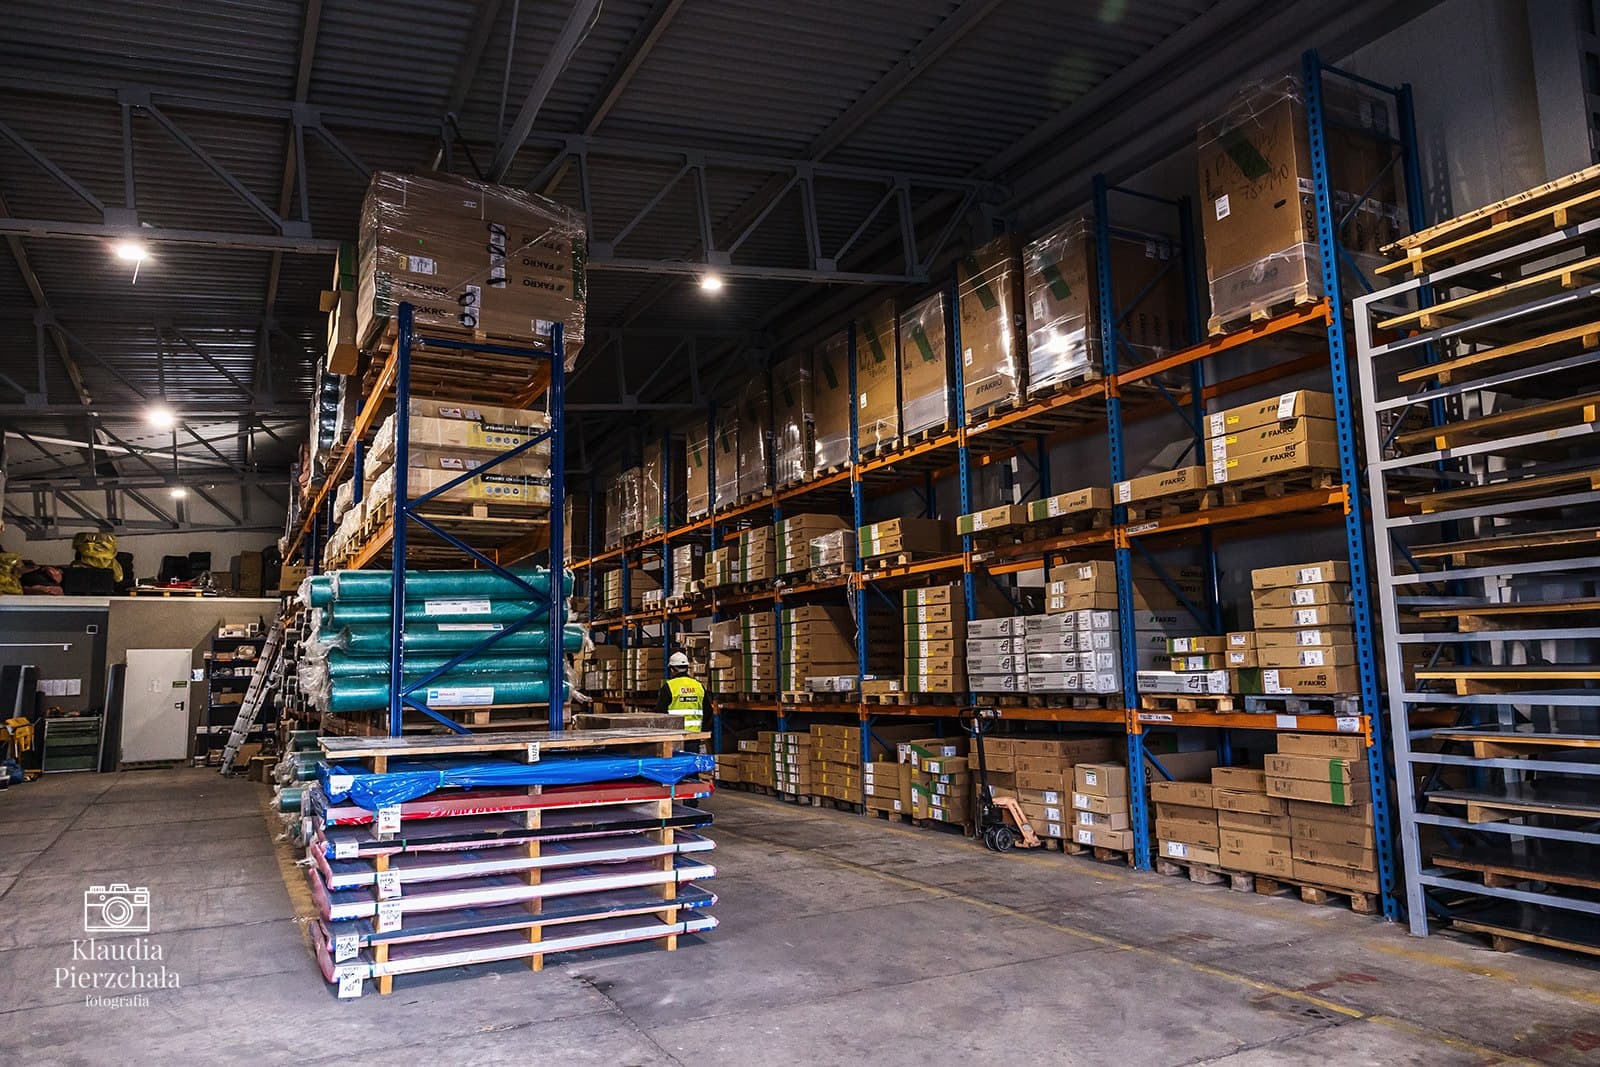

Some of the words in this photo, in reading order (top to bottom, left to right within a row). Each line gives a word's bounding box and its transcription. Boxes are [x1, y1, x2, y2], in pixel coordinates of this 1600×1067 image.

[523, 279, 554, 290] FAKRO
[1268, 427, 1294, 437] FAKRO
[1270, 451, 1296, 462] FAKRO
